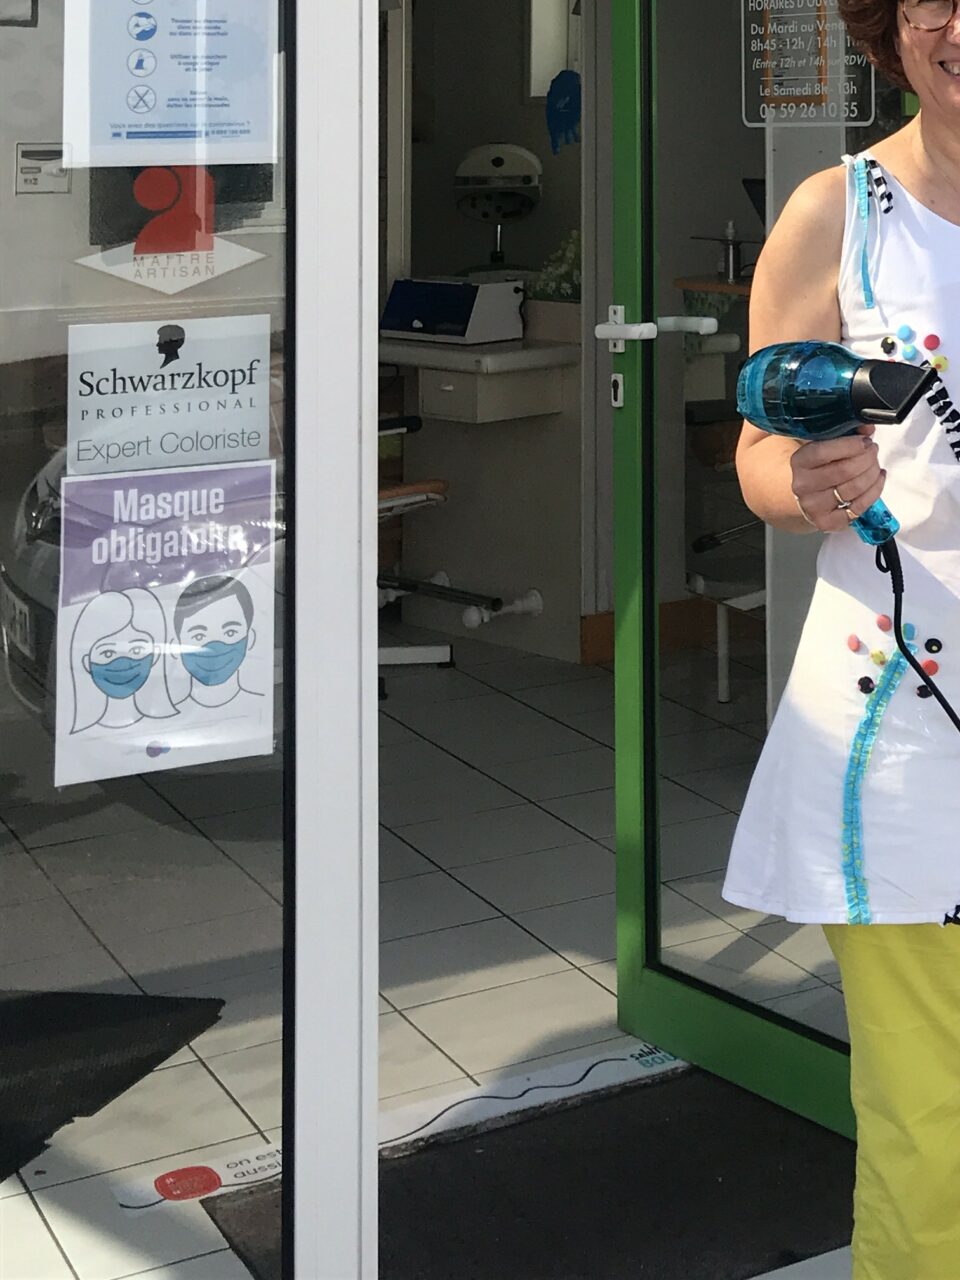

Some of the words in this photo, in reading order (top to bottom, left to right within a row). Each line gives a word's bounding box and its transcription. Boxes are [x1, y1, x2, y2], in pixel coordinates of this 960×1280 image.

[751, 24, 764, 35] Du
[768, 21, 798, 34] Mardi
[800, 23, 814, 32] au
[750, 38, 777, 52] 8h45
[786, 36, 805, 50] 12h
[816, 35, 837, 49] 14h
[752, 58, 777, 70] (Entre
[780, 57, 796, 69] 12h
[797, 58, 807, 68] et
[844, 54, 867, 67] RDV)
[759, 85, 771, 97] Le
[773, 82, 812, 96] Samedi
[814, 82, 828, 95] 8h
[760, 103, 776, 119] 05
[780, 103, 796, 118] 59
[800, 102, 816, 118] 26
[821, 102, 837, 118] 10
[842, 101, 858, 118] 55
[134, 265, 215, 279] ARTISAN
[78, 359, 261, 397] Schwarzkopf
[81, 398, 257, 421] PROFESSIONAL
[77, 435, 151, 464] Expert
[160, 428, 261, 455] Coloriste
[113, 487, 225, 523] Masque
[92, 521, 246, 565] obligatoire
[226, 1158, 251, 1169] on
[255, 1148, 282, 1161] est
[233, 1162, 282, 1179] aussi
